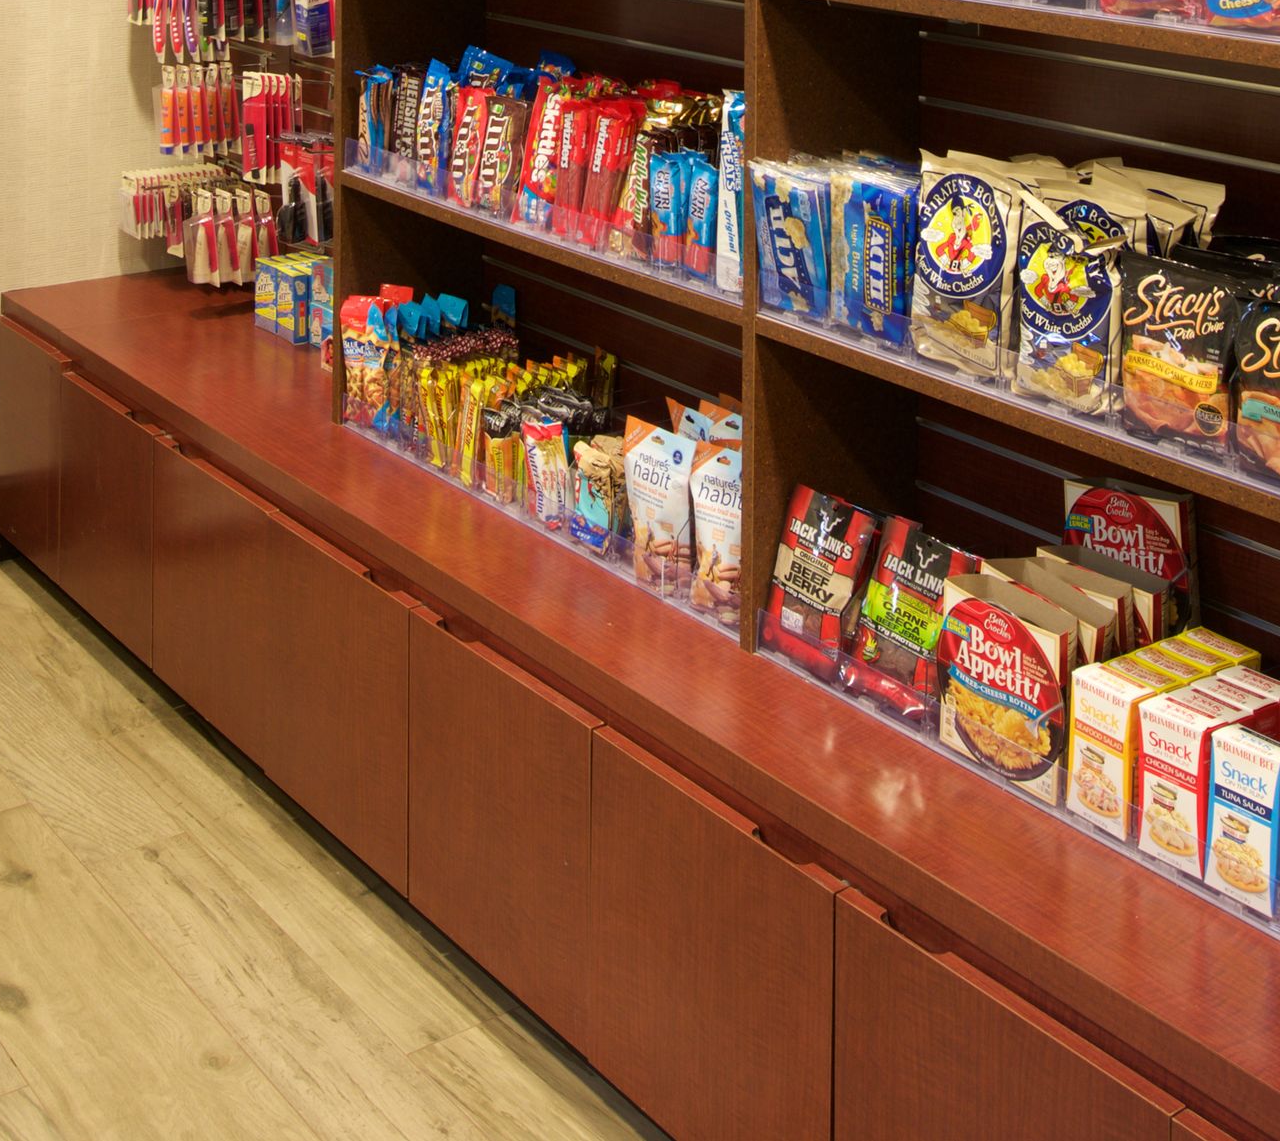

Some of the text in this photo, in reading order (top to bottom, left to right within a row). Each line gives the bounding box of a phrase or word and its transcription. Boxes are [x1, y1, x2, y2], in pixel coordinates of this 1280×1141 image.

[529, 92, 562, 184] Skittles
[560, 111, 575, 169] Twizzlers
[591, 114, 610, 173] Twizzlers
[723, 209, 738, 254] Original
[928, 272, 984, 293] White Cheddar
[1124, 274, 1225, 336] Stacy's
[1034, 313, 1094, 334] White Cheddar
[638, 451, 670, 469] nature's
[632, 464, 671, 491] habit
[703, 474, 740, 491] nature's
[1092, 514, 1145, 550] Bowl
[784, 571, 834, 604] JERKY
[790, 560, 829, 588] BEEF
[882, 599, 929, 631] CARNE
[885, 610, 921, 637] SECA
[969, 623, 1022, 673] Bowl
[956, 648, 1040, 705] Appétit!
[1080, 698, 1120, 729] Snack
[1148, 731, 1192, 763] Snack
[1221, 761, 1268, 795] Snack
[1220, 788, 1266, 816] TUNA SALAD
